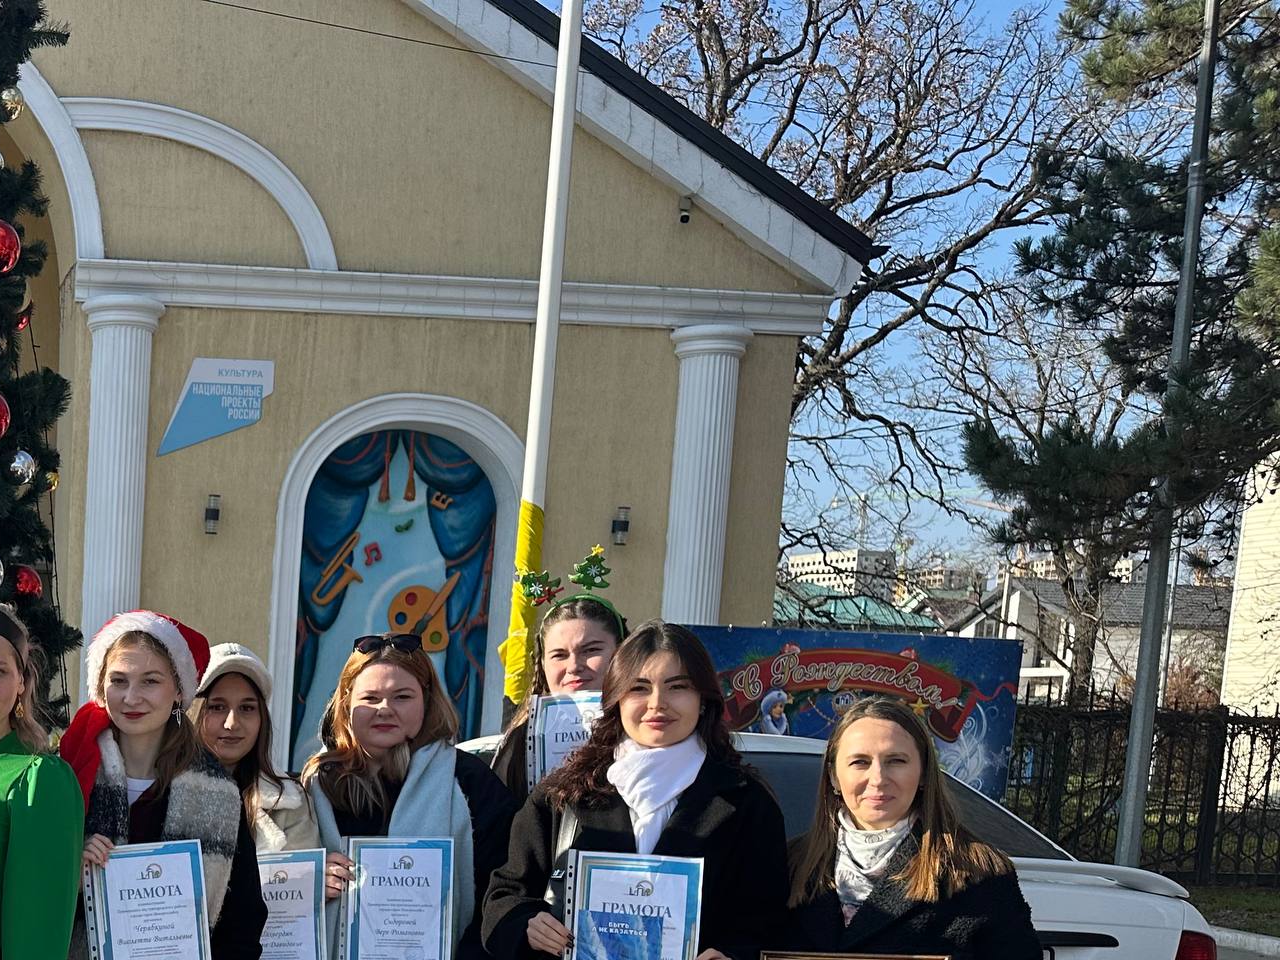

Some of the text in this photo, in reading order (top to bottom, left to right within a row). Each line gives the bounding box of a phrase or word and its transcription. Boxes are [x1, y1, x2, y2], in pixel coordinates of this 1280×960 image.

[218, 368, 263, 378] КУЛЬТУРА
[192, 383, 261, 396] НАЦИОНАЛЬНЫЕ
[221, 396, 260, 408] ПРОЕКТЫ
[228, 408, 260, 420] РОССИИ
[733, 651, 958, 710] С Рождеством!
[371, 876, 430, 887] ГРАМОТА
[119, 885, 183, 901] ГРАМОТА
[601, 902, 672, 918] ГРАМОТА
[608, 921, 630, 929] БЫТЬ
[609, 928, 648, 937] КАЗАТЬСЯ
